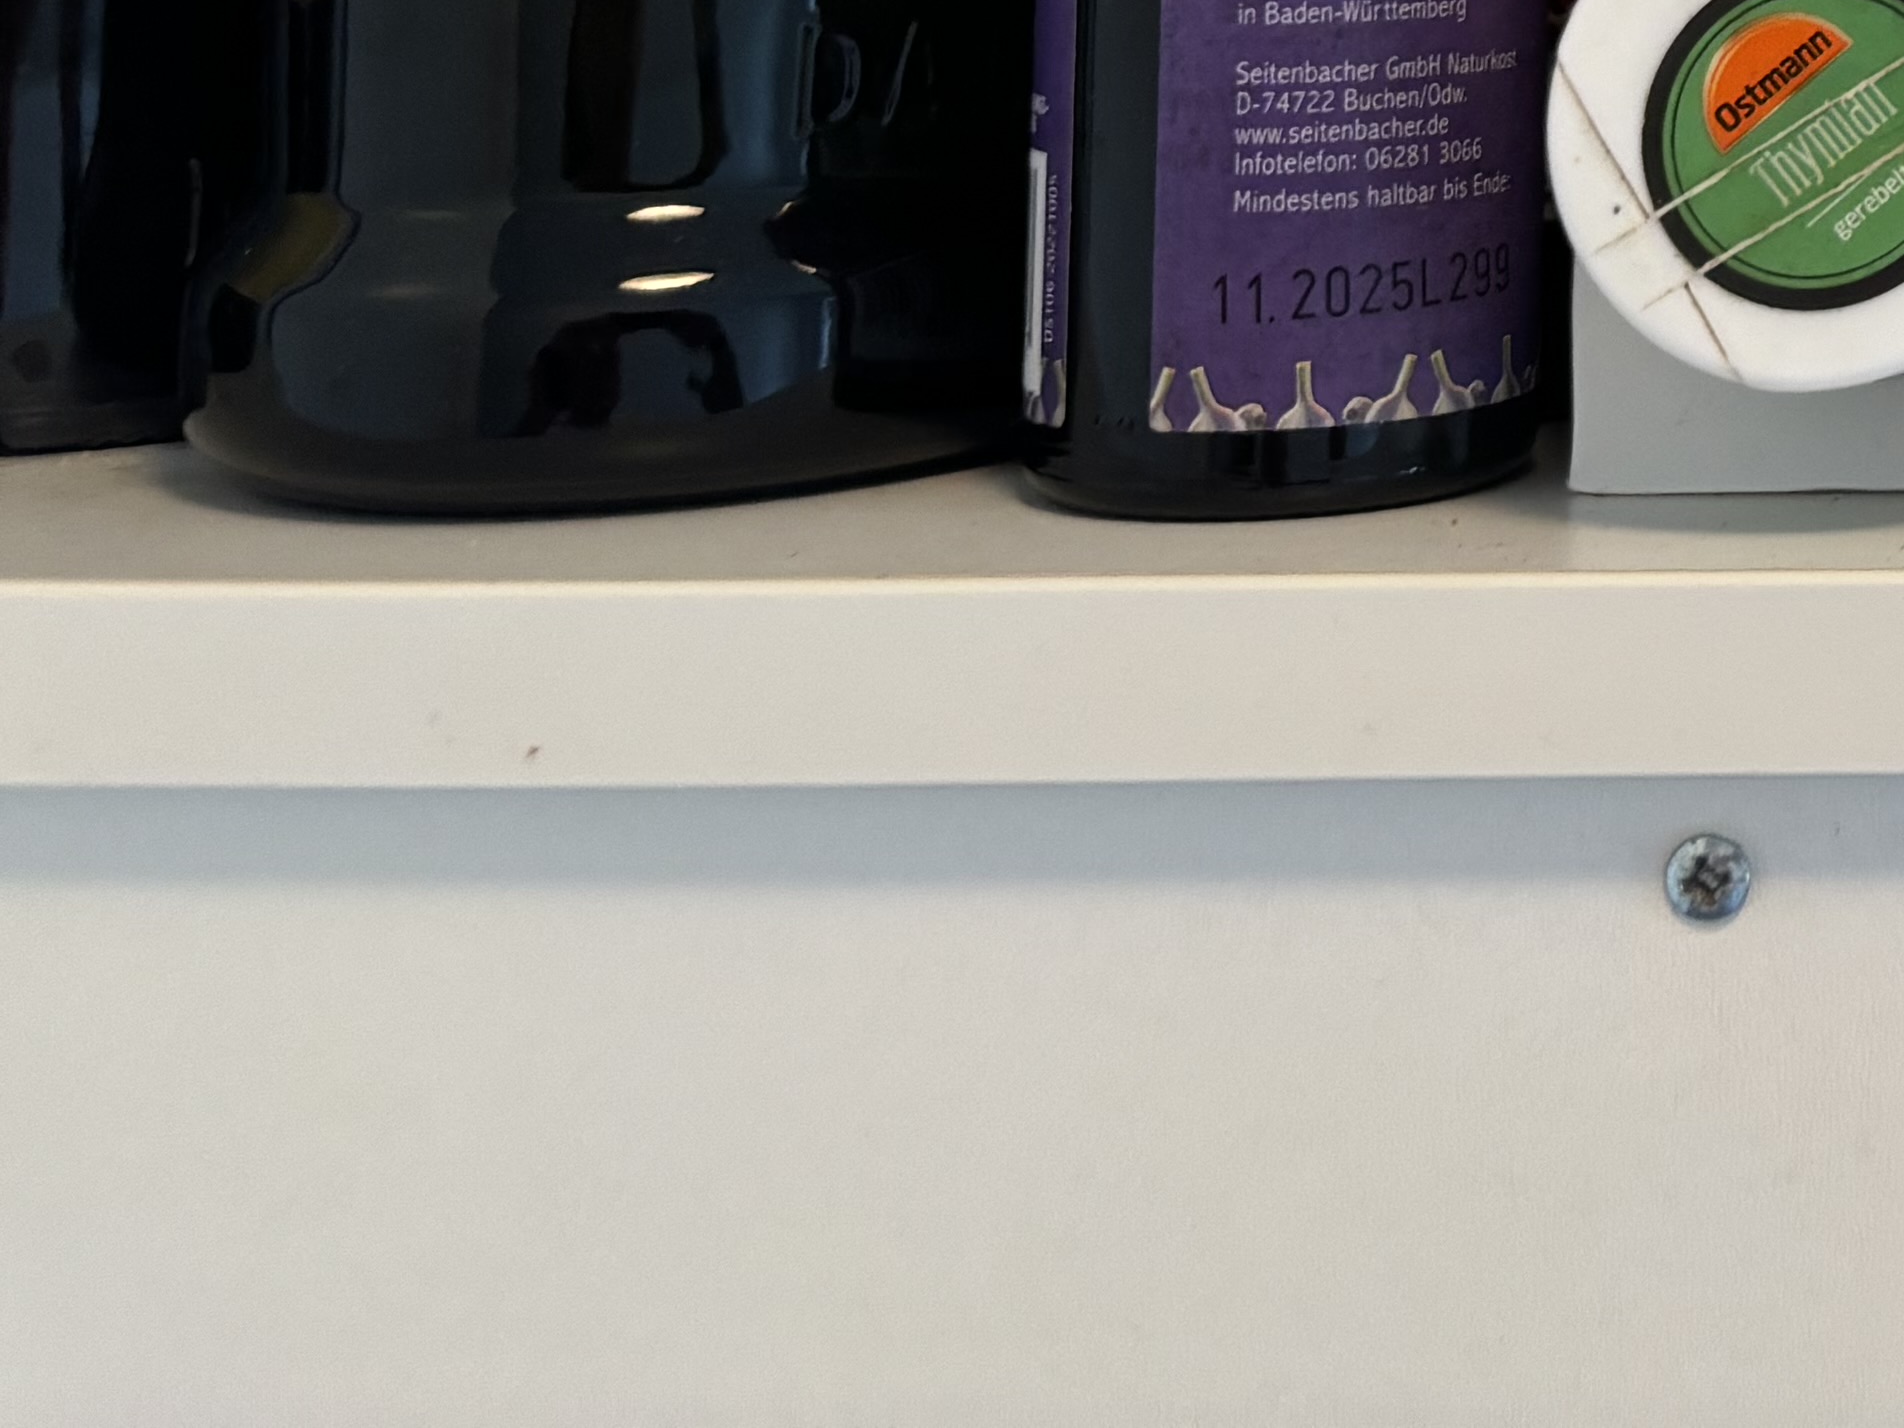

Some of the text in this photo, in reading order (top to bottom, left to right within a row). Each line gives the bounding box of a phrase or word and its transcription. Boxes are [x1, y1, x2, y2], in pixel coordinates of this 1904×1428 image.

[1236, 56, 1441, 85] Seitenbacher GmbH
[1714, 30, 1832, 134] Ostmann
[1237, 84, 1467, 117] D-74722 Buchen/Odw.
[1235, 114, 1449, 144] www.seitenbacher.de
[1750, 79, 1898, 208] Thymian
[1235, 138, 1482, 175] Infotelefon: 06281 3066
[1234, 177, 1467, 212] Mindestens haltbar bis
[1213, 245, 1510, 324] 11.2025L299
